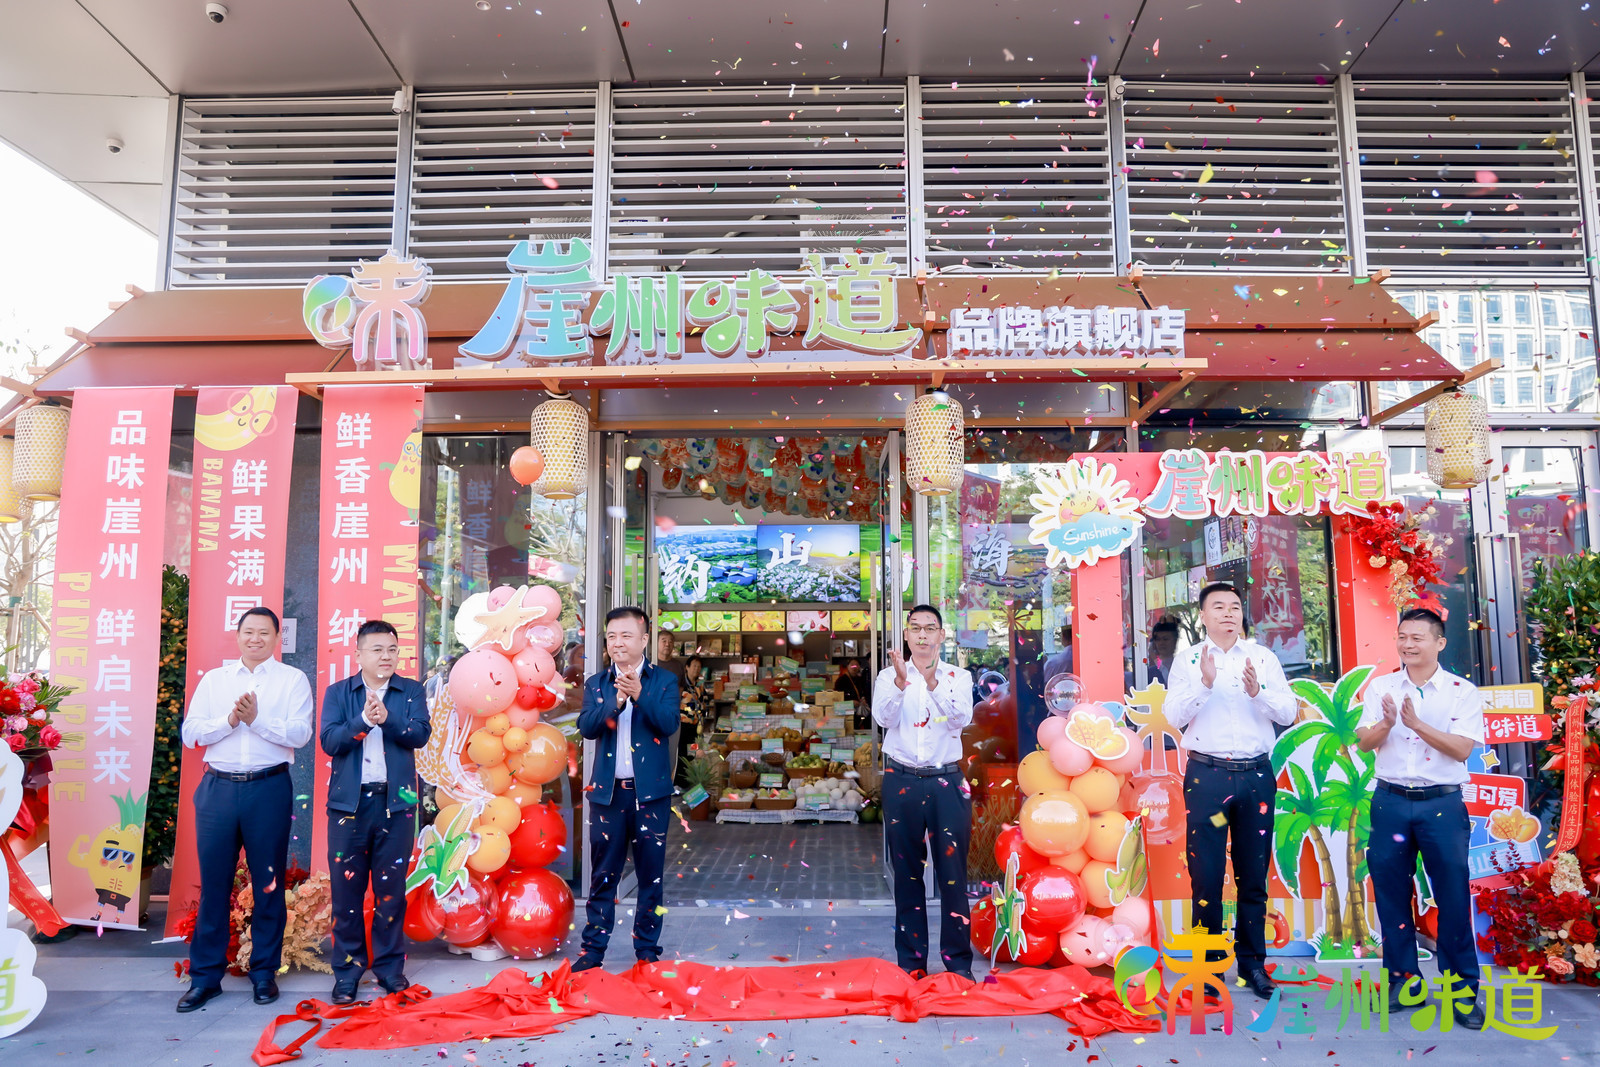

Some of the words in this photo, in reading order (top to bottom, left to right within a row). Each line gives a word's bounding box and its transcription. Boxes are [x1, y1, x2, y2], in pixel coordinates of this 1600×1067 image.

[458, 237, 923, 359] 崖州味道
[949, 305, 1186, 354] 品牌旗舰店
[99, 410, 147, 581] 品味崖州
[197, 457, 223, 553] BANANA
[330, 412, 372, 585] 鲜香崖州
[1062, 522, 1121, 546] Sunshine
[1145, 449, 1399, 516] 崖州味道
[223, 458, 269, 633] 鲜果满园
[766, 532, 813, 570] 山
[970, 531, 1015, 577] 海
[55, 571, 92, 803] PINEAPPLE
[92, 608, 136, 786] 鲜启未来
